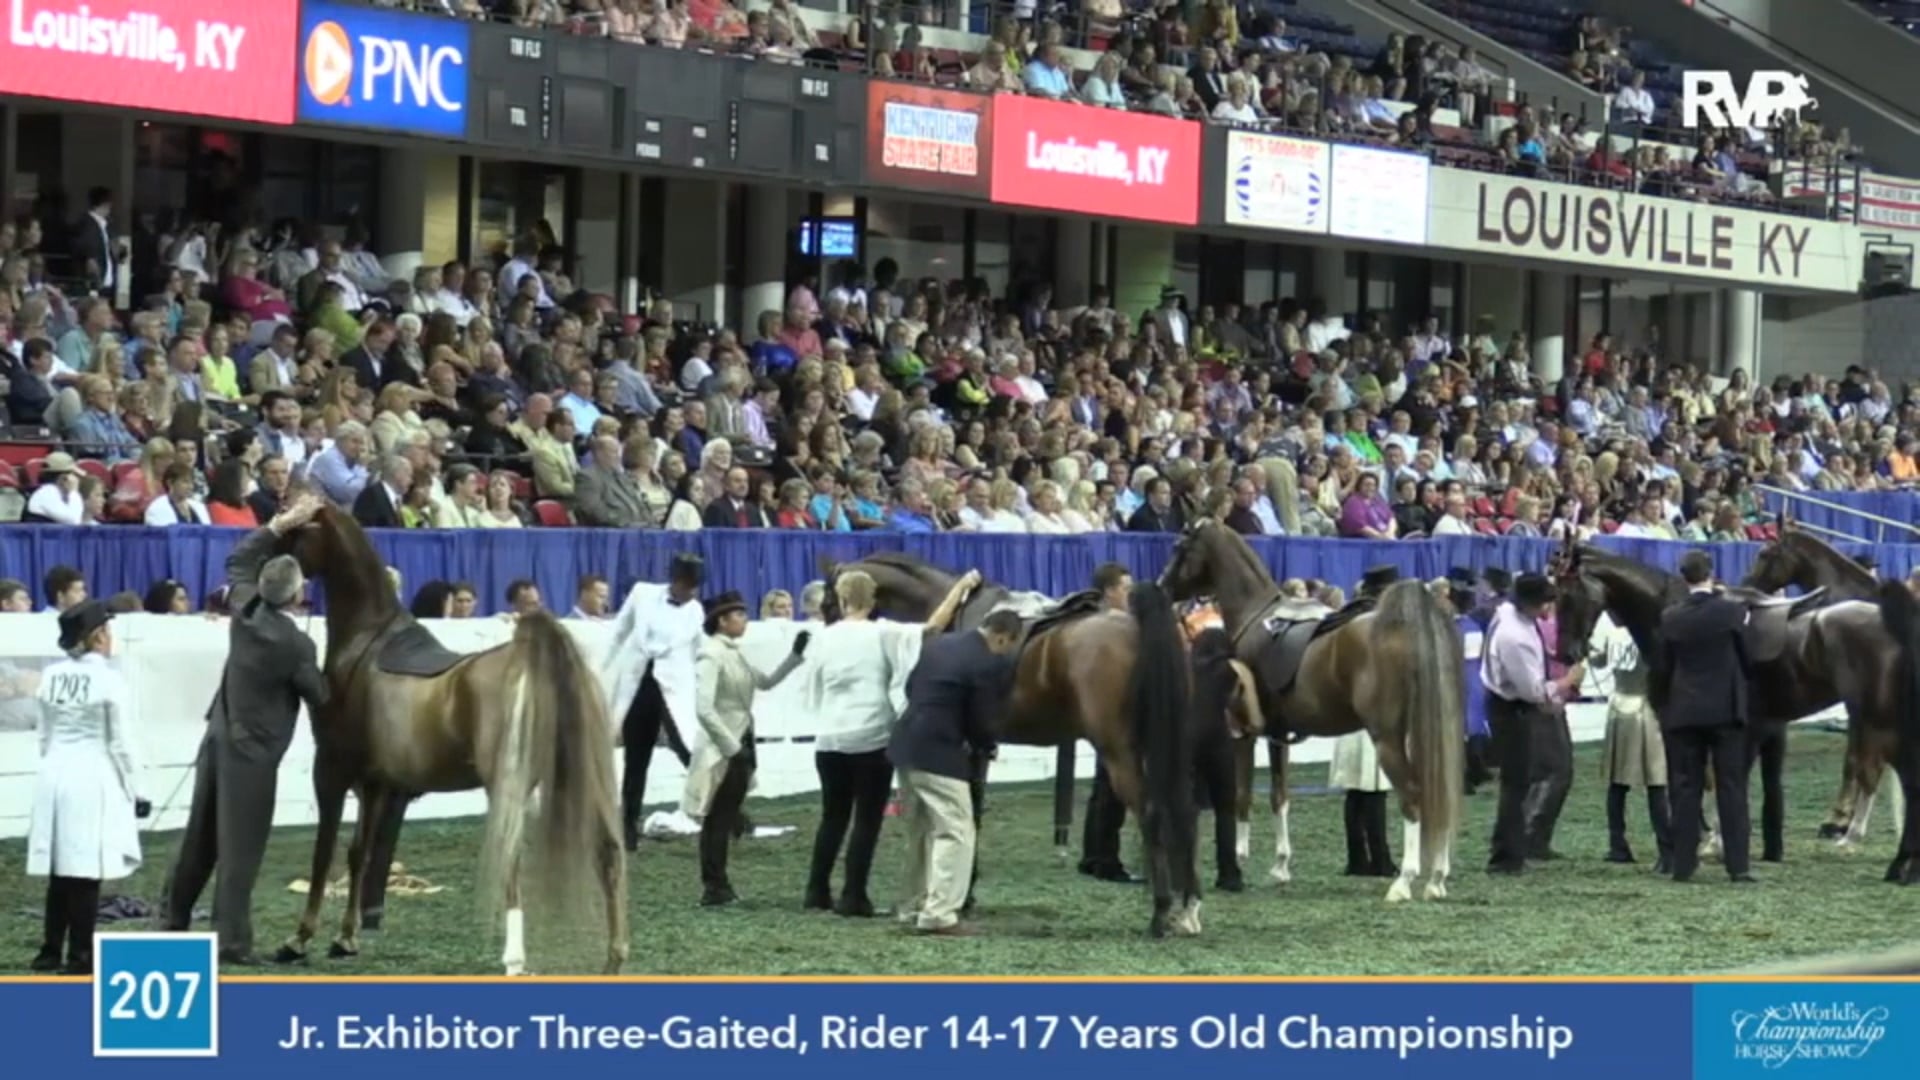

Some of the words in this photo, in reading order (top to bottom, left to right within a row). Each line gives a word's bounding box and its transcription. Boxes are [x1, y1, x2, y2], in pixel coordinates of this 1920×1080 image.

[11, 0, 186, 72] Louisville,
[195, 20, 245, 71] KY
[359, 35, 463, 111] PNC
[885, 102, 978, 146] KENTUCKY
[883, 136, 940, 172] STATE
[1027, 131, 1133, 185] Louisville,
[1137, 146, 1168, 184] KY
[1478, 182, 1734, 270] LOUISVILLE
[1759, 221, 1810, 278] KY
[50, 672, 91, 704] 1293
